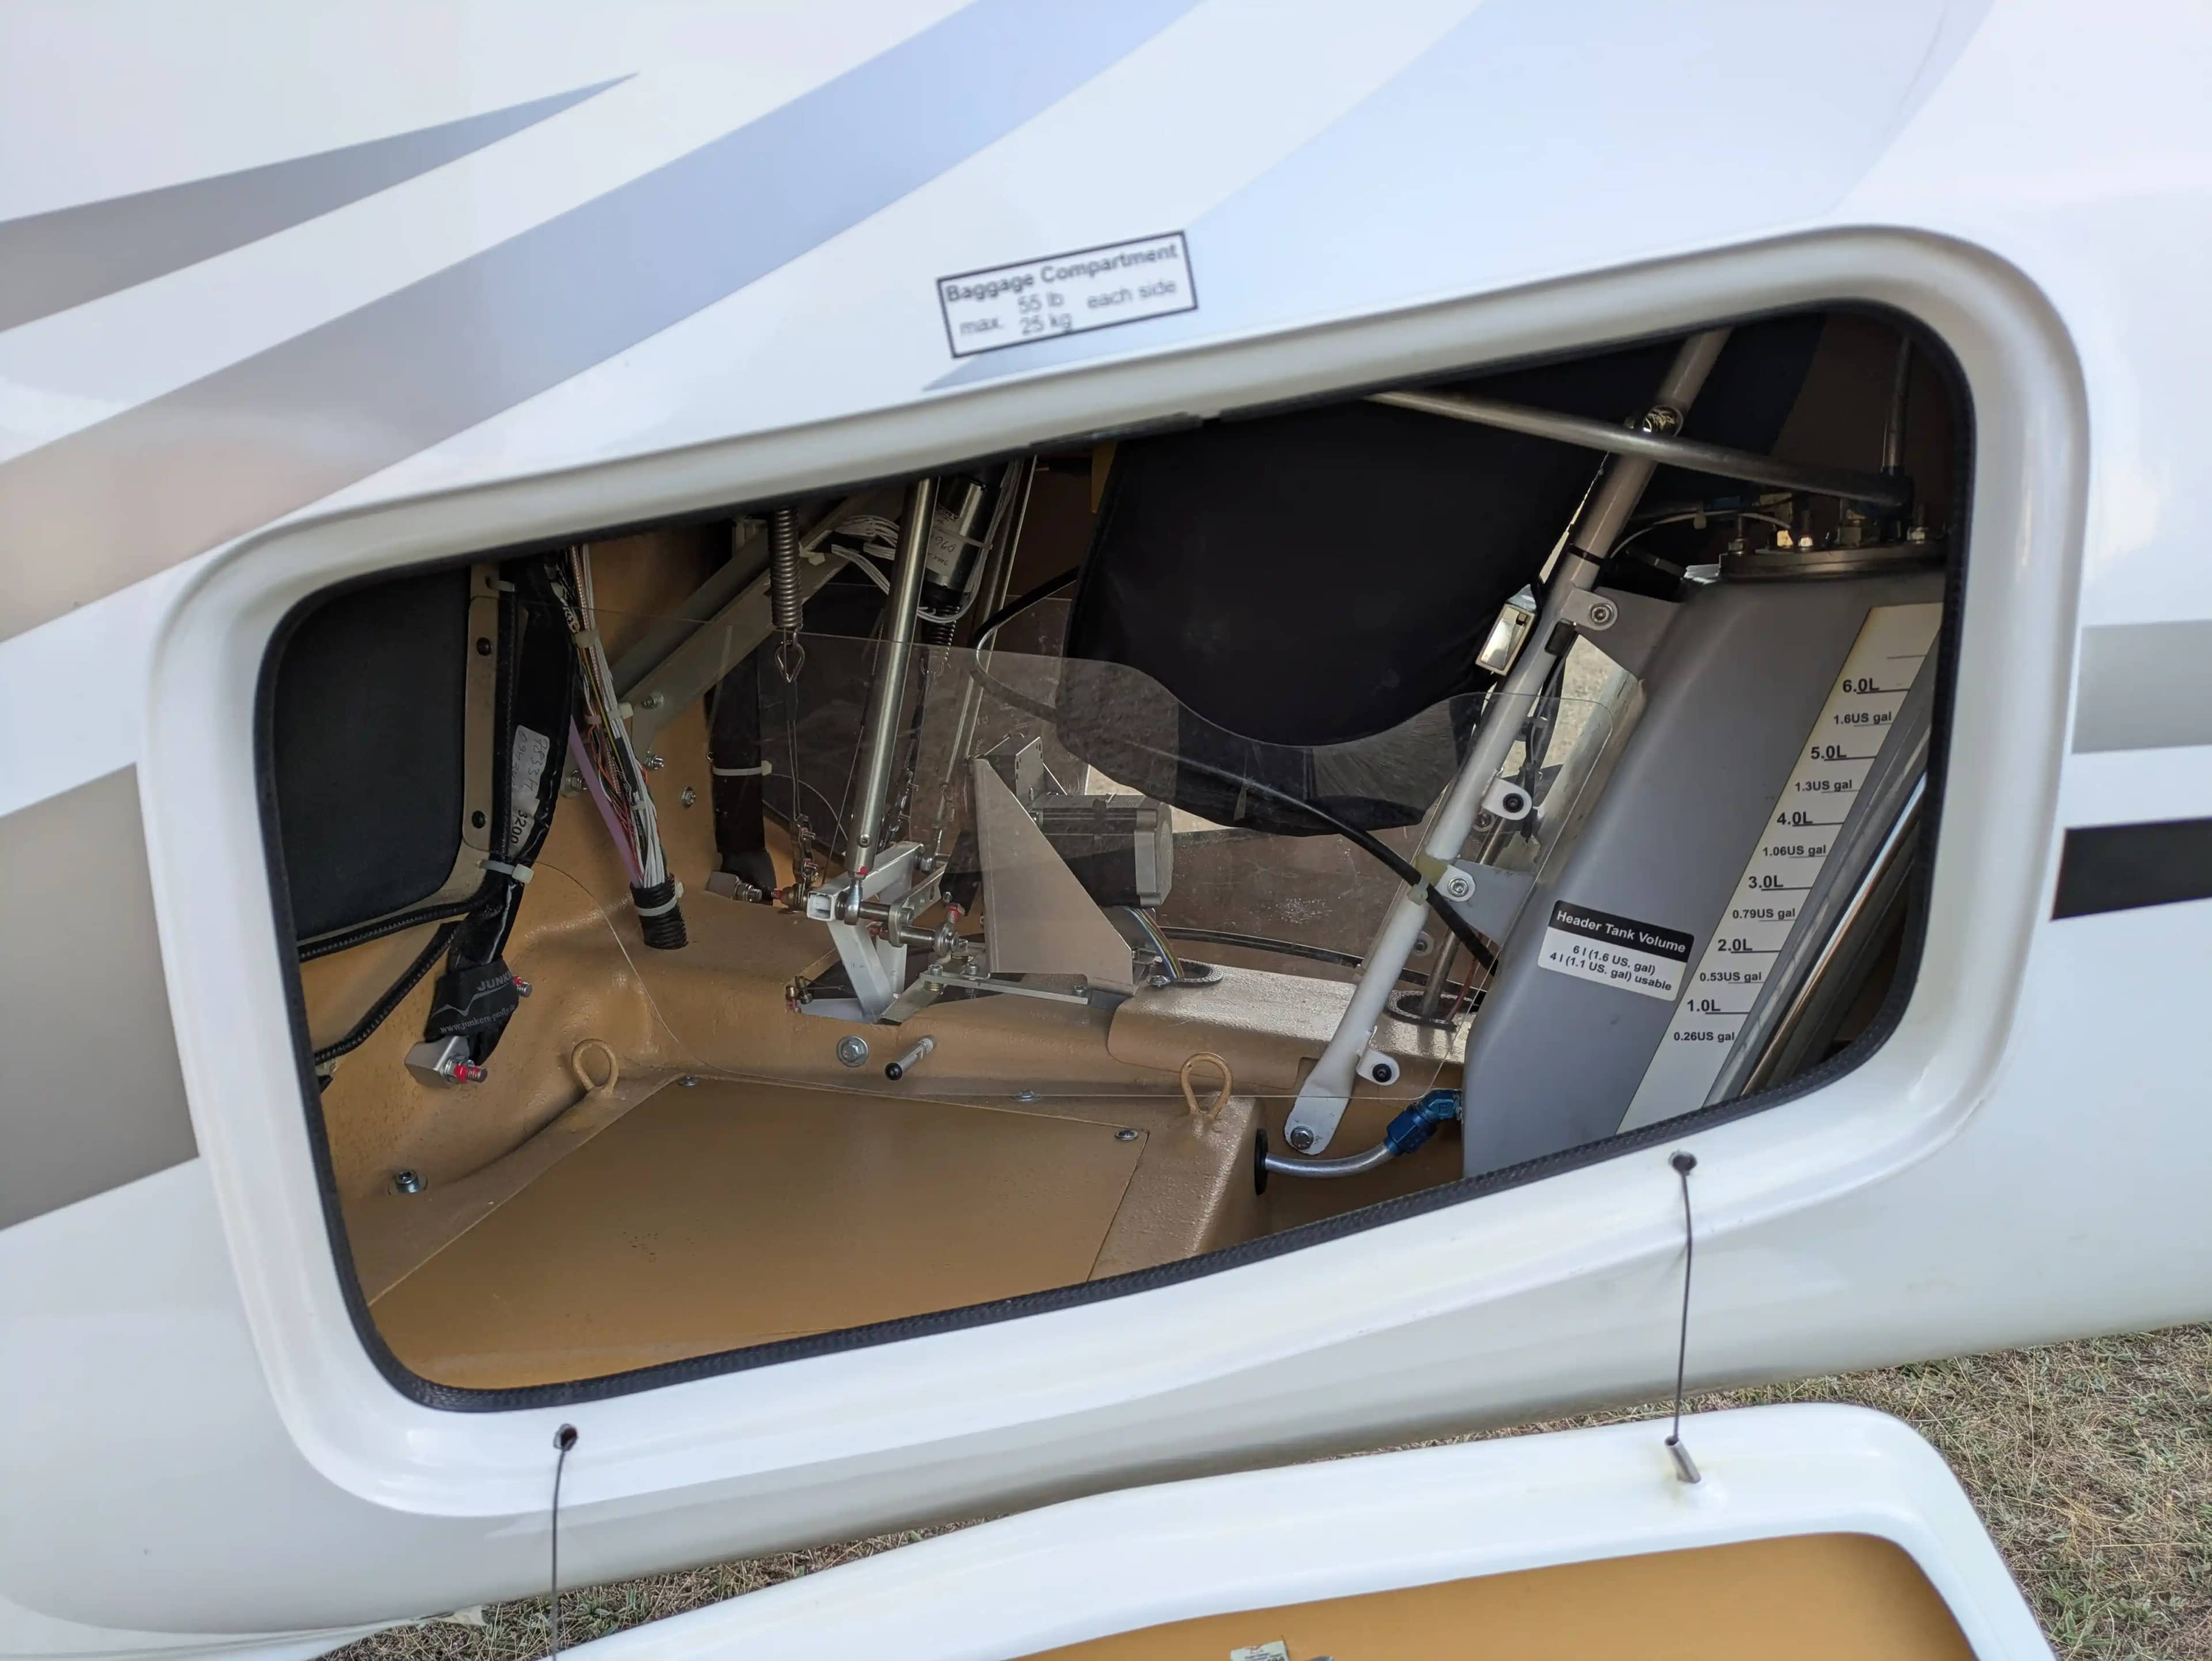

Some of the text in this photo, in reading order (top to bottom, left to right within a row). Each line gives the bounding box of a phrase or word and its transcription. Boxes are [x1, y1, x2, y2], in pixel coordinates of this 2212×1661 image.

[946, 244, 1178, 302] Baggage Compartment
[1086, 280, 1176, 309] each side
[1018, 292, 1064, 314] 55 lb
[960, 317, 1003, 335] max.
[1020, 312, 1072, 335] 25 kg
[1843, 678, 1880, 693] 6.0L
[1834, 712, 1892, 724] 1.6US gal
[1811, 746, 1847, 759] 5.0L
[1795, 780, 1853, 792] 1.3US gal
[1777, 812, 1813, 825] 4.0L
[511, 810, 528, 843] 3200
[1763, 845, 1826, 857] 1.06US gal
[1748, 875, 1783, 888] 3.0L
[1732, 908, 1796, 920] 0.79US gal
[1556, 910, 1686, 953] Header Tank Volume
[1718, 939, 1752, 951] 2.0L
[1573, 945, 1580, 954] 6
[1589, 949, 1609, 962] (1.6
[1612, 956, 1630, 968] US.
[1634, 963, 1656, 976] gal)
[1550, 952, 1556, 961] 4
[1566, 956, 1585, 968] (1.1
[1589, 962, 1607, 974] US.
[1611, 968, 1631, 982] gal)
[1635, 975, 1672, 991] usable
[1700, 971, 1762, 983] 0.53US gal
[1687, 1000, 1721, 1012] 1.0L
[1674, 1031, 1735, 1042] 0.26US gal
